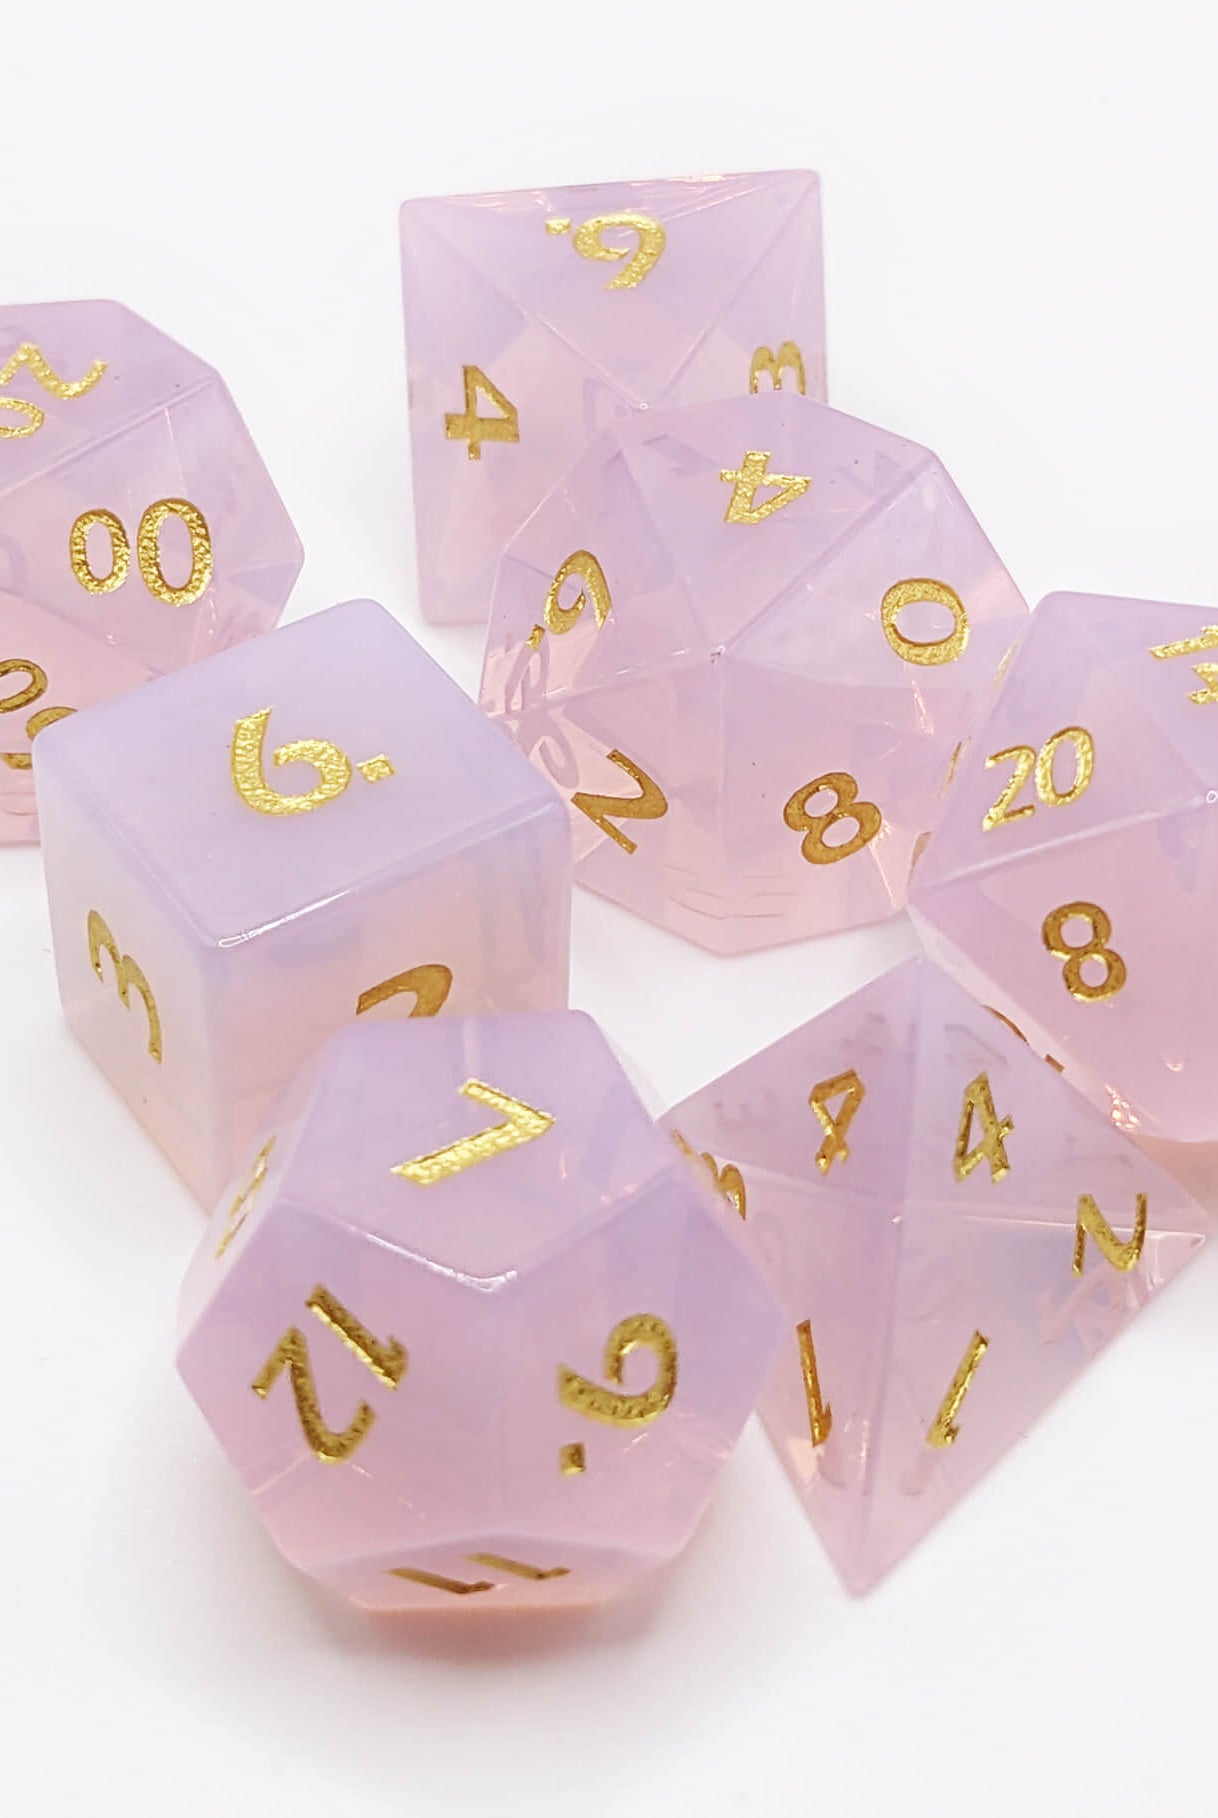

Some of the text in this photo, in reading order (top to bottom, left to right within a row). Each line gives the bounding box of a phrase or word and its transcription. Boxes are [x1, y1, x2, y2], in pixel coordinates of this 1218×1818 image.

[544, 211, 667, 291] 6.
[444, 364, 520, 461] 4
[718, 450, 812, 526] 4
[67, 497, 214, 607] 00
[880, 577, 971, 667] 0
[228, 707, 397, 818] 6.
[570, 749, 669, 856] 2
[982, 725, 1097, 832] 20
[782, 771, 891, 867] 8
[86, 908, 167, 1072] 3
[1040, 901, 1128, 1005] 8
[391, 1078, 556, 1188] 7
[808, 1068, 866, 1176] 4
[954, 1071, 1014, 1184] 4
[1071, 1192, 1149, 1279] 2
[250, 1285, 409, 1466] 12
[794, 1320, 834, 1448] 1
[925, 1329, 990, 1450] 1
